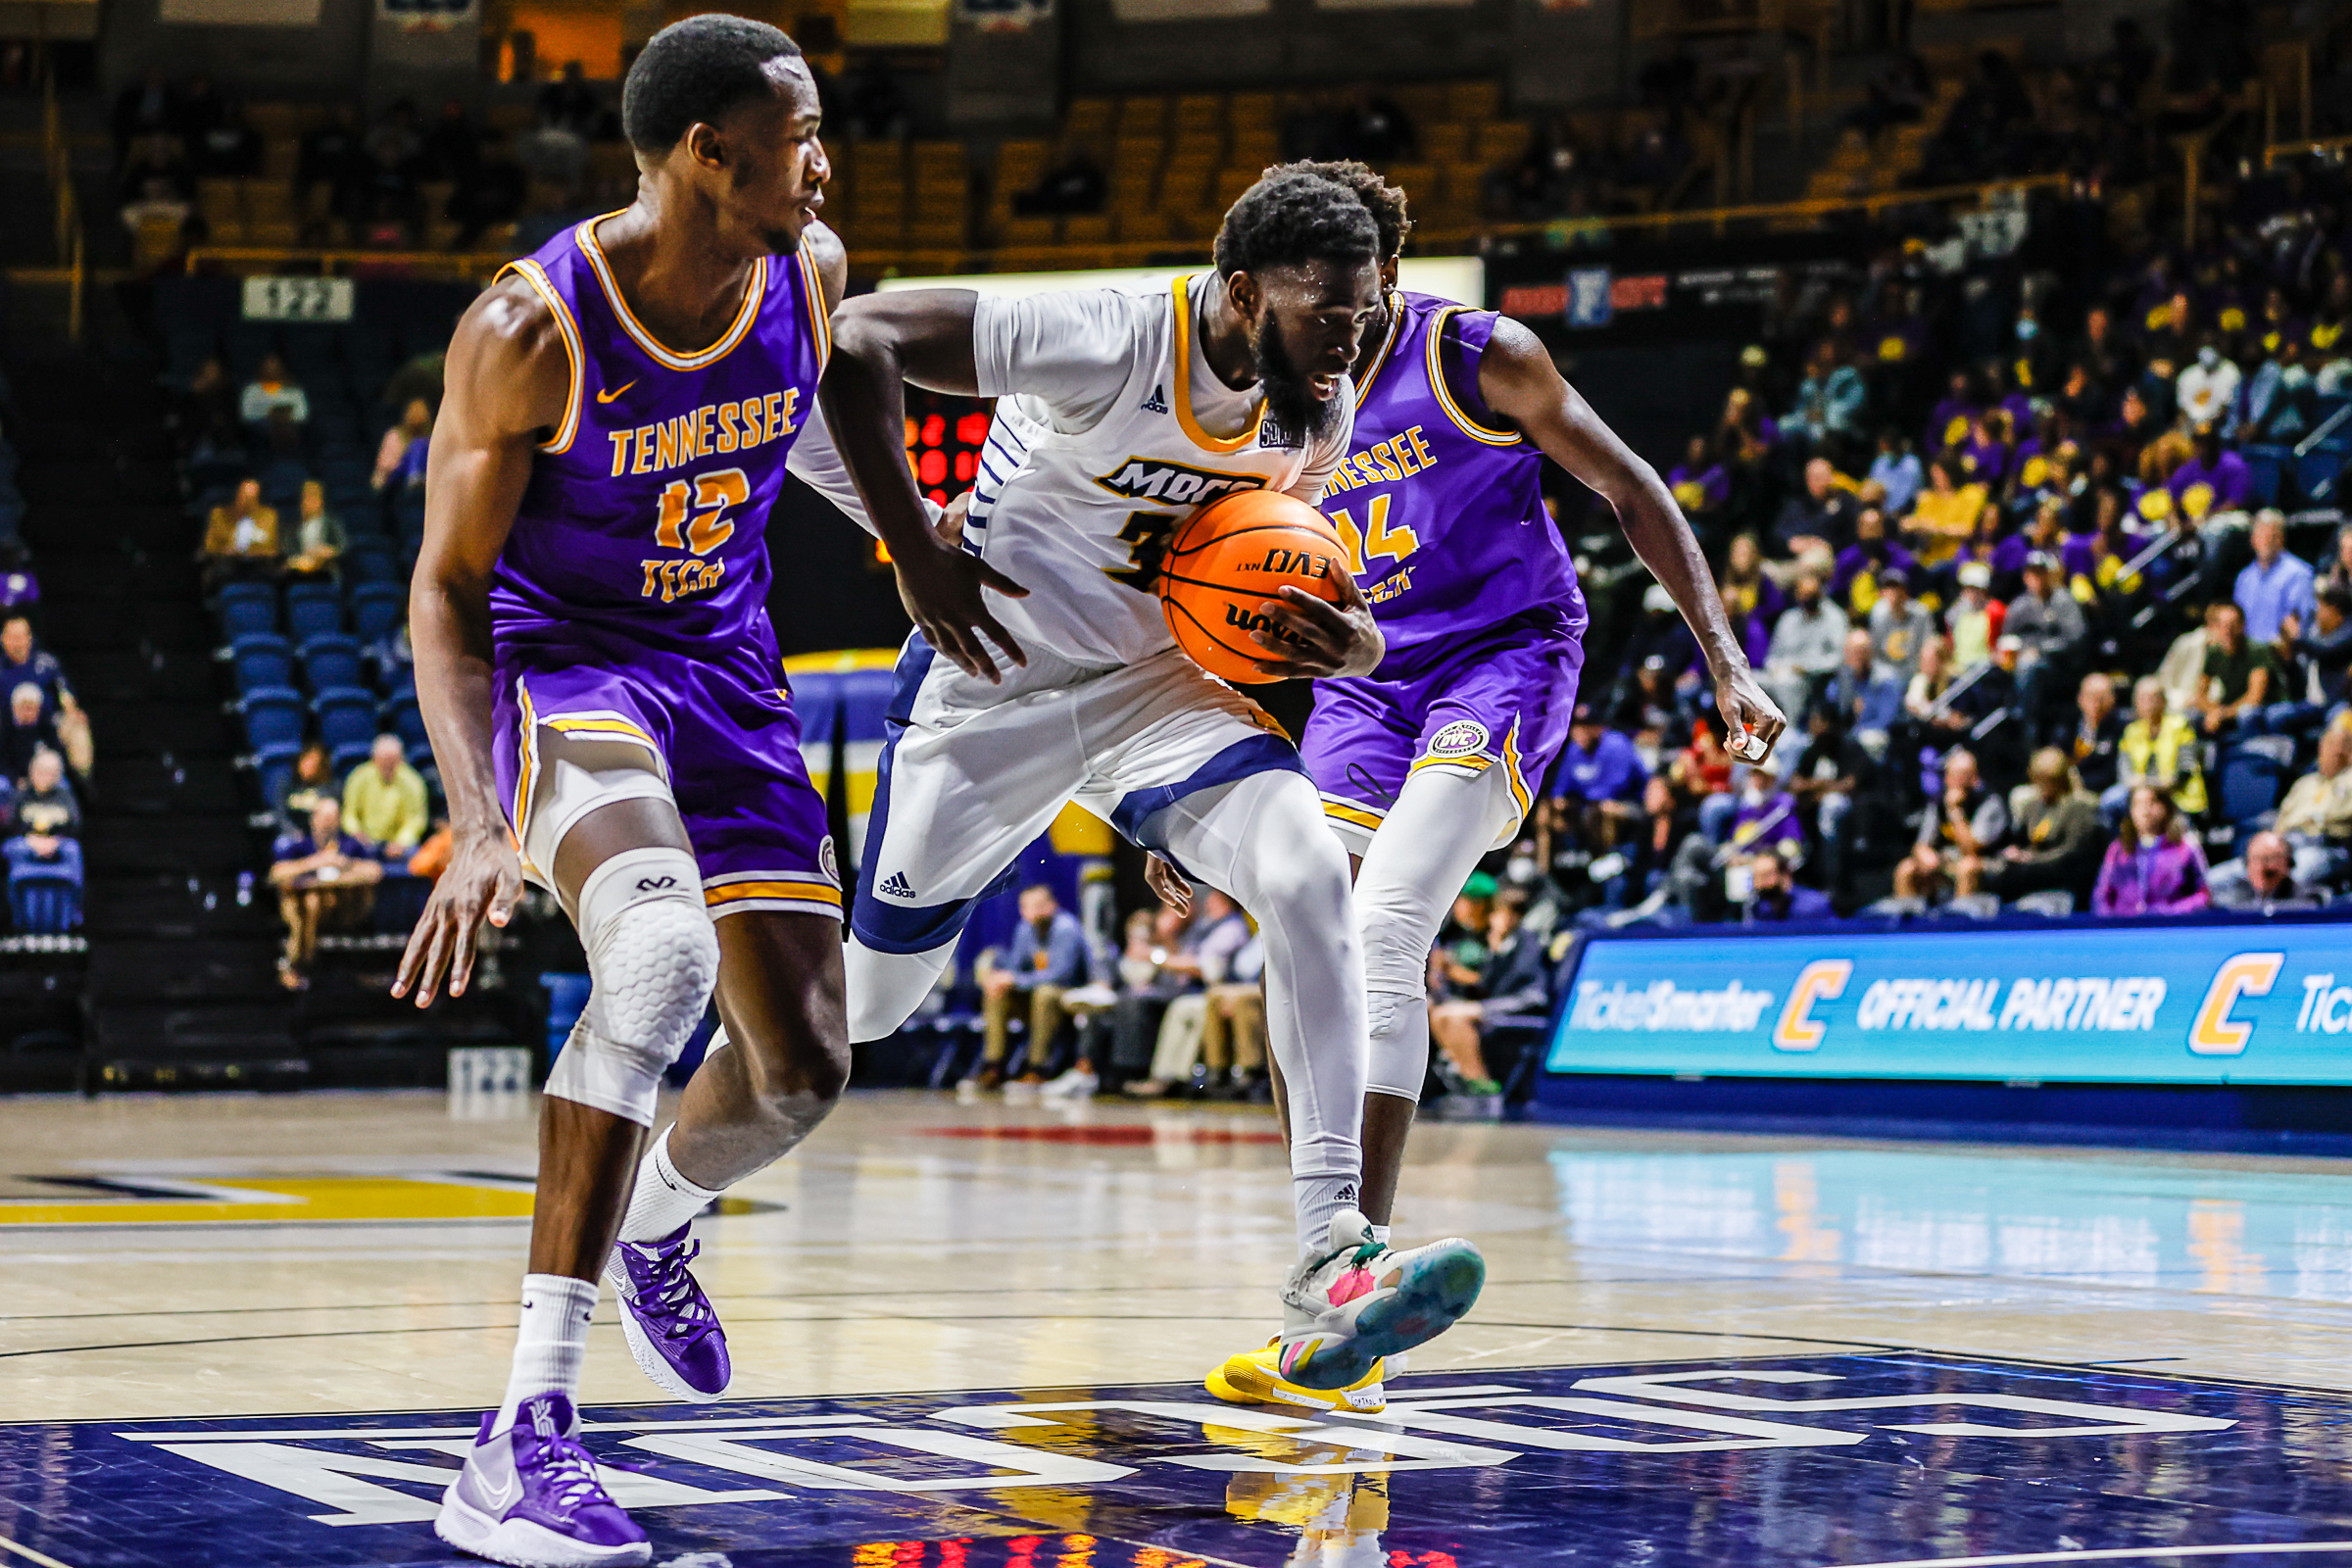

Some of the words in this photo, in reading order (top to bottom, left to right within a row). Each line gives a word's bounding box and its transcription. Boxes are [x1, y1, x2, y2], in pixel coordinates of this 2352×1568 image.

[266, 278, 332, 318] 122
[609, 387, 800, 477] TENNESSEE
[1323, 424, 1438, 498] NESSEE
[655, 467, 750, 556] 12
[1328, 493, 1420, 576] 14
[641, 558, 725, 603] TECH
[1262, 549, 1331, 580] EVO
[1439, 732, 1473, 748] OVC
[879, 883, 916, 899] adidas
[1857, 978, 2000, 1031] OFFICIAL
[1997, 977, 2167, 1031] PARTNER
[2295, 972, 2352, 1035] Tic
